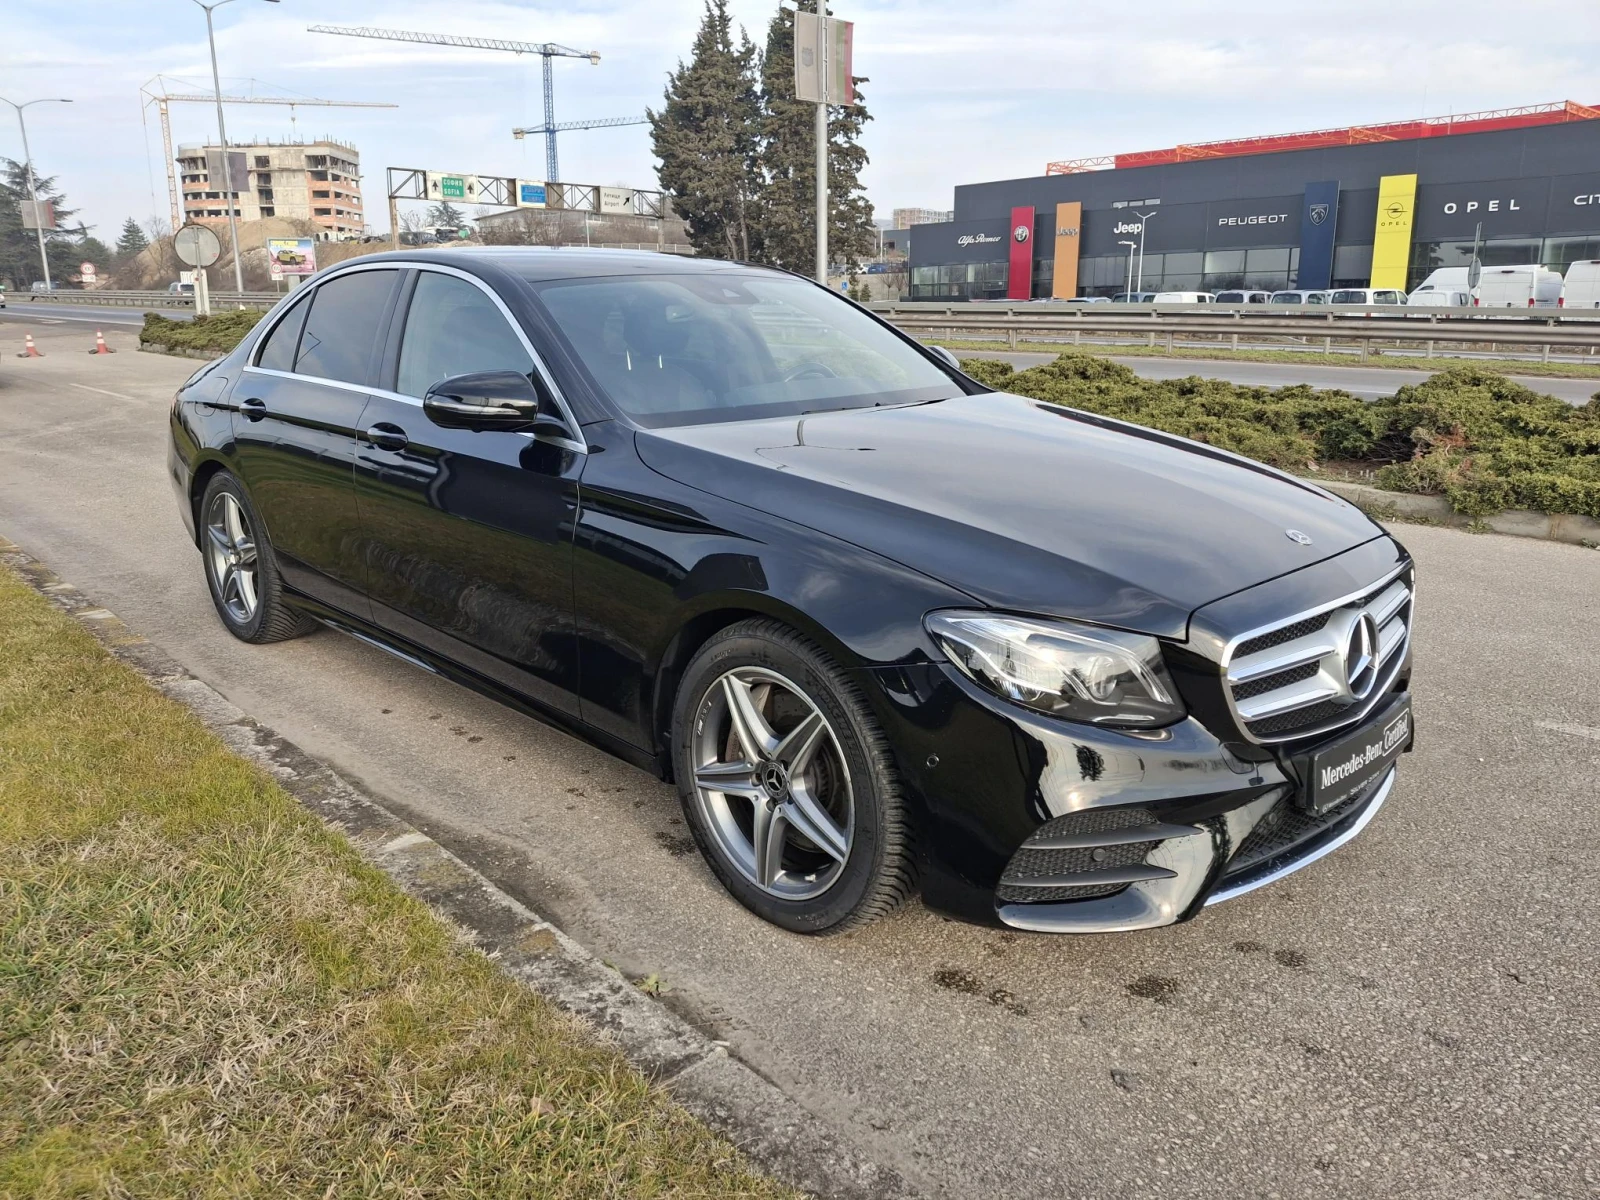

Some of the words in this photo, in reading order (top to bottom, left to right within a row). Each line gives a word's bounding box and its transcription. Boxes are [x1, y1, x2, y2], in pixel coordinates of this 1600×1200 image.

[1444, 199, 1520, 214] OPEL
[1218, 214, 1288, 226] PEUGEOT
[1057, 226, 1078, 236] Jeep
[1113, 221, 1142, 234] Jeep
[958, 235, 975, 247] Alfa
[975, 233, 1001, 243] Romeo
[1321, 741, 1383, 789] Mercedes-Benz
[1384, 714, 1408, 749] Certified
